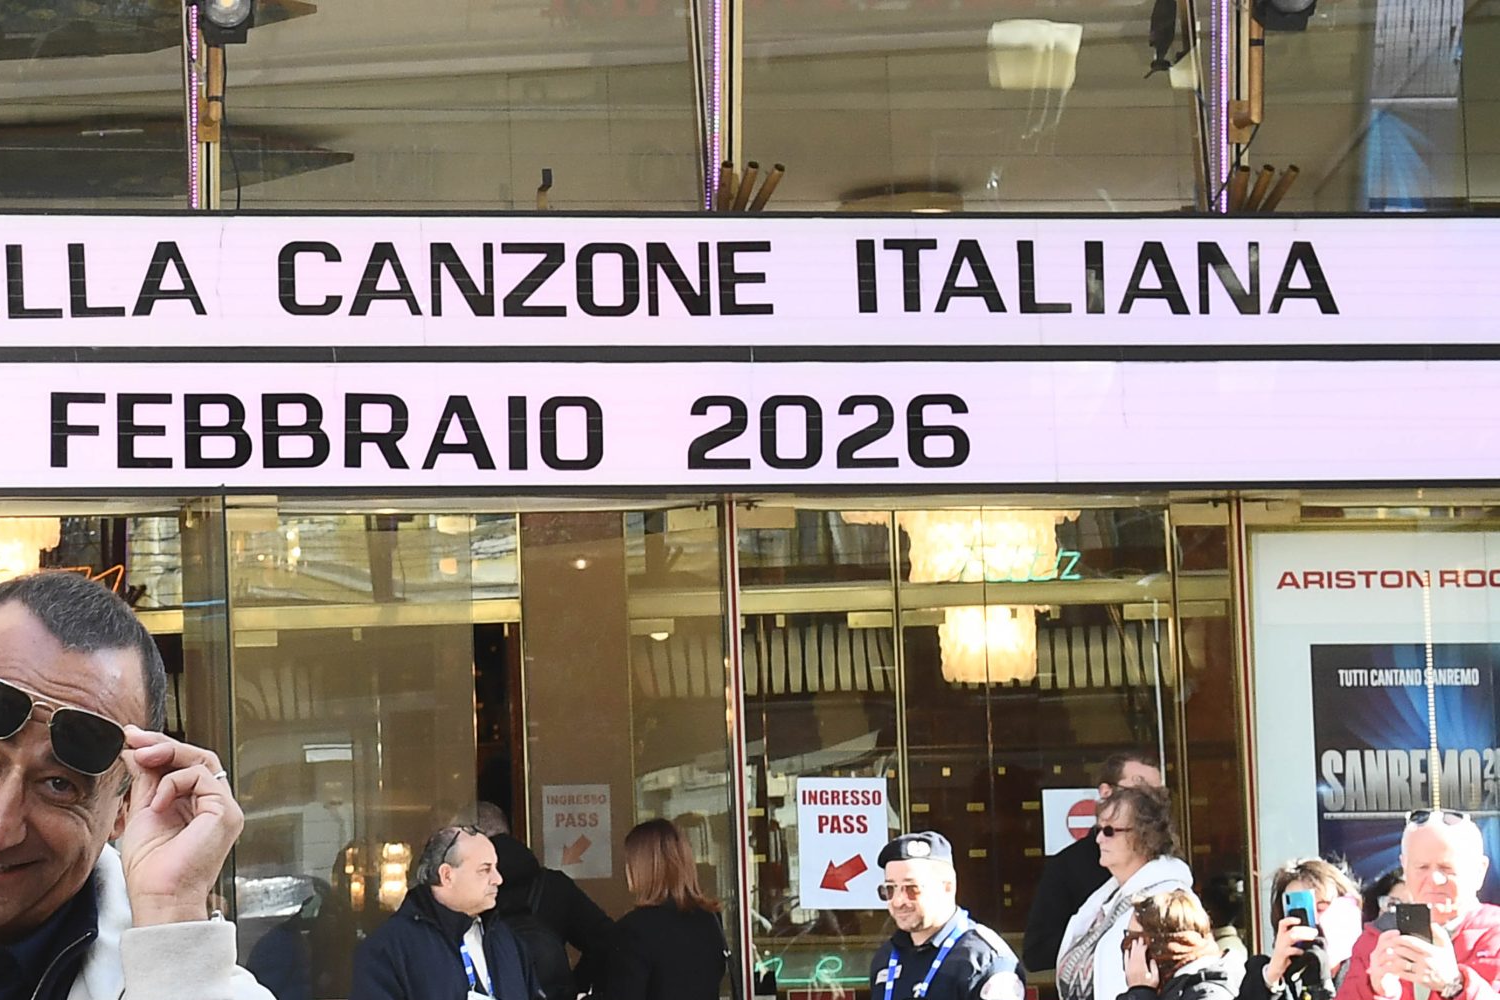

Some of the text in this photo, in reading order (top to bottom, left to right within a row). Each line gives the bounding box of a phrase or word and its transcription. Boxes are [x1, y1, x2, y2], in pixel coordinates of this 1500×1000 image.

[278, 240, 774, 317] CANZONE
[856, 239, 1340, 316] ITALIANA
[50, 391, 604, 471] FEBBRAIO
[688, 393, 971, 470] 2026
[1276, 570, 1431, 590] ARISTON
[1338, 669, 1368, 687] TUTTI
[1370, 669, 1422, 686] CANTANO
[1321, 749, 1482, 812] SANREMO
[801, 789, 882, 806] INGRESSO
[555, 812, 599, 828] PASS
[817, 815, 868, 834] PASS
